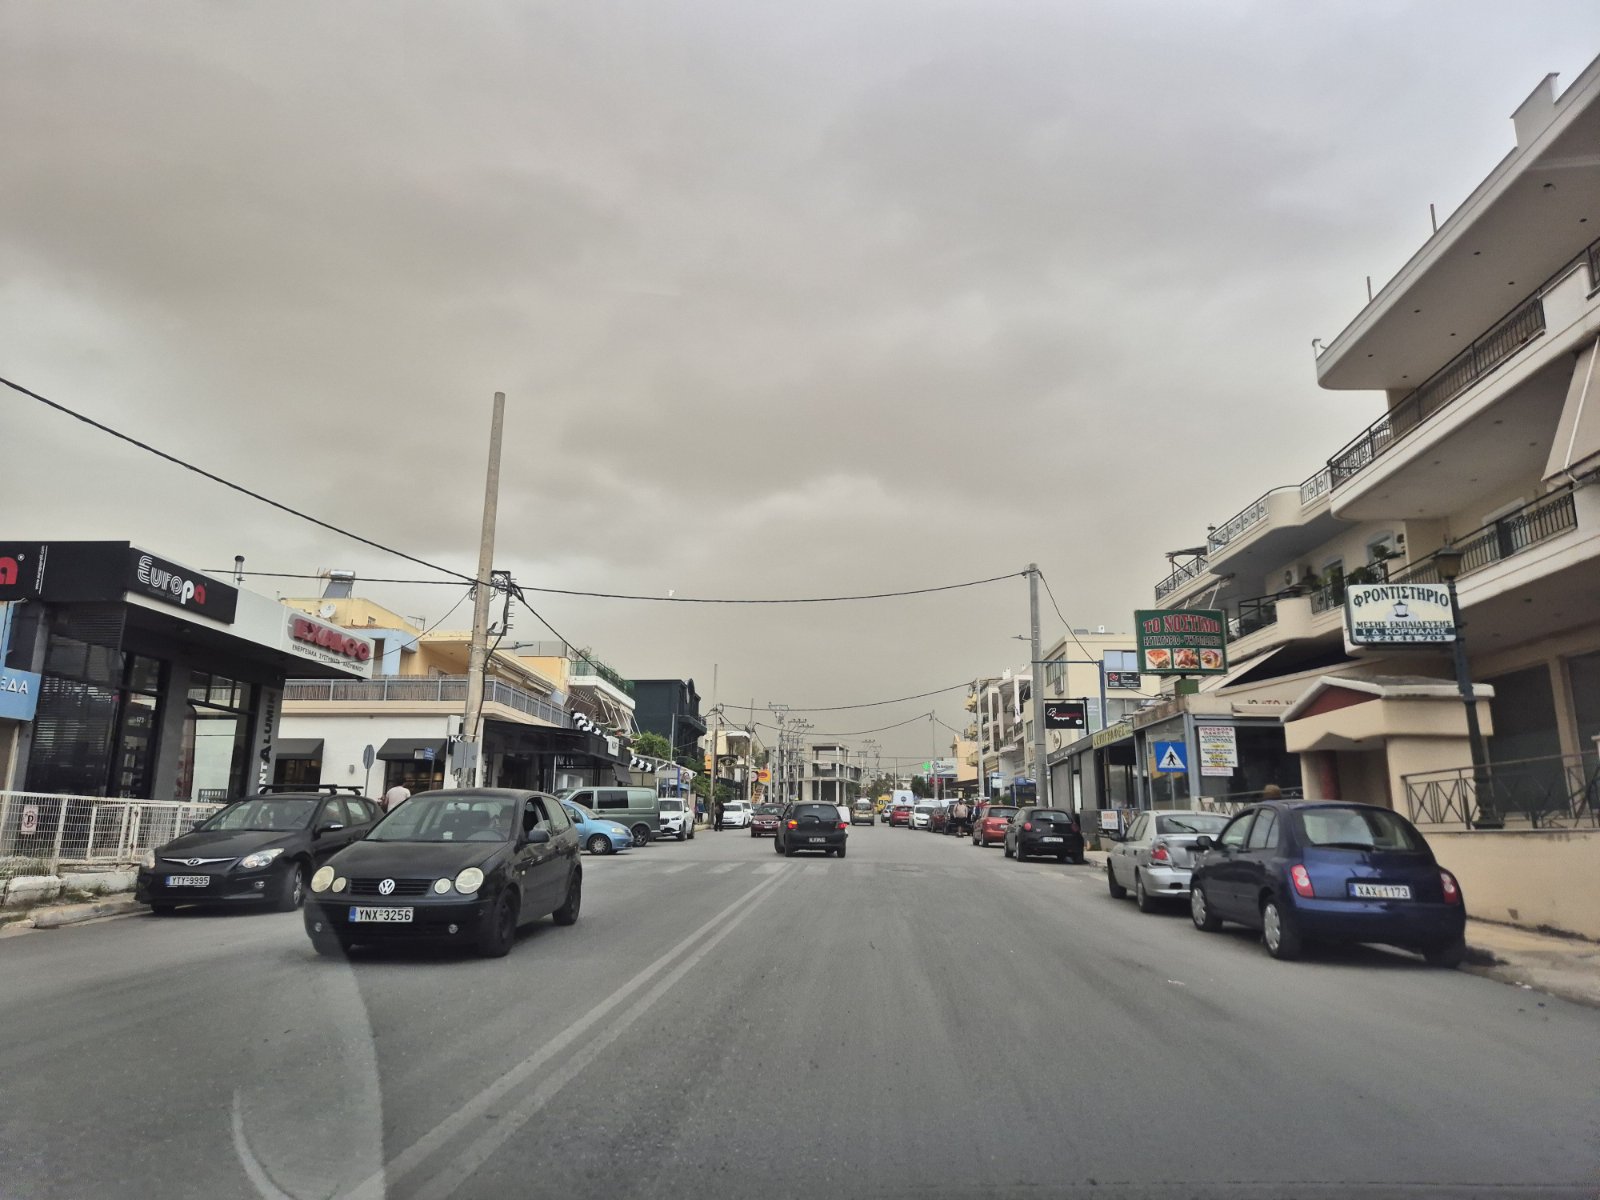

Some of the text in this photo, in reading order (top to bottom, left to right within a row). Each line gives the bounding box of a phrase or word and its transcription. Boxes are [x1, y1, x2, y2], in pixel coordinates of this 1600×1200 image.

[138, 555, 206, 605] Europa
[1353, 586, 1449, 607] ΦΡΟΝΤΙΣΤΗΡΙΟ
[1143, 614, 1221, 633] ΤΟ ΝΟΣΤΙΜΟ
[359, 908, 411, 921] YNX-3256
